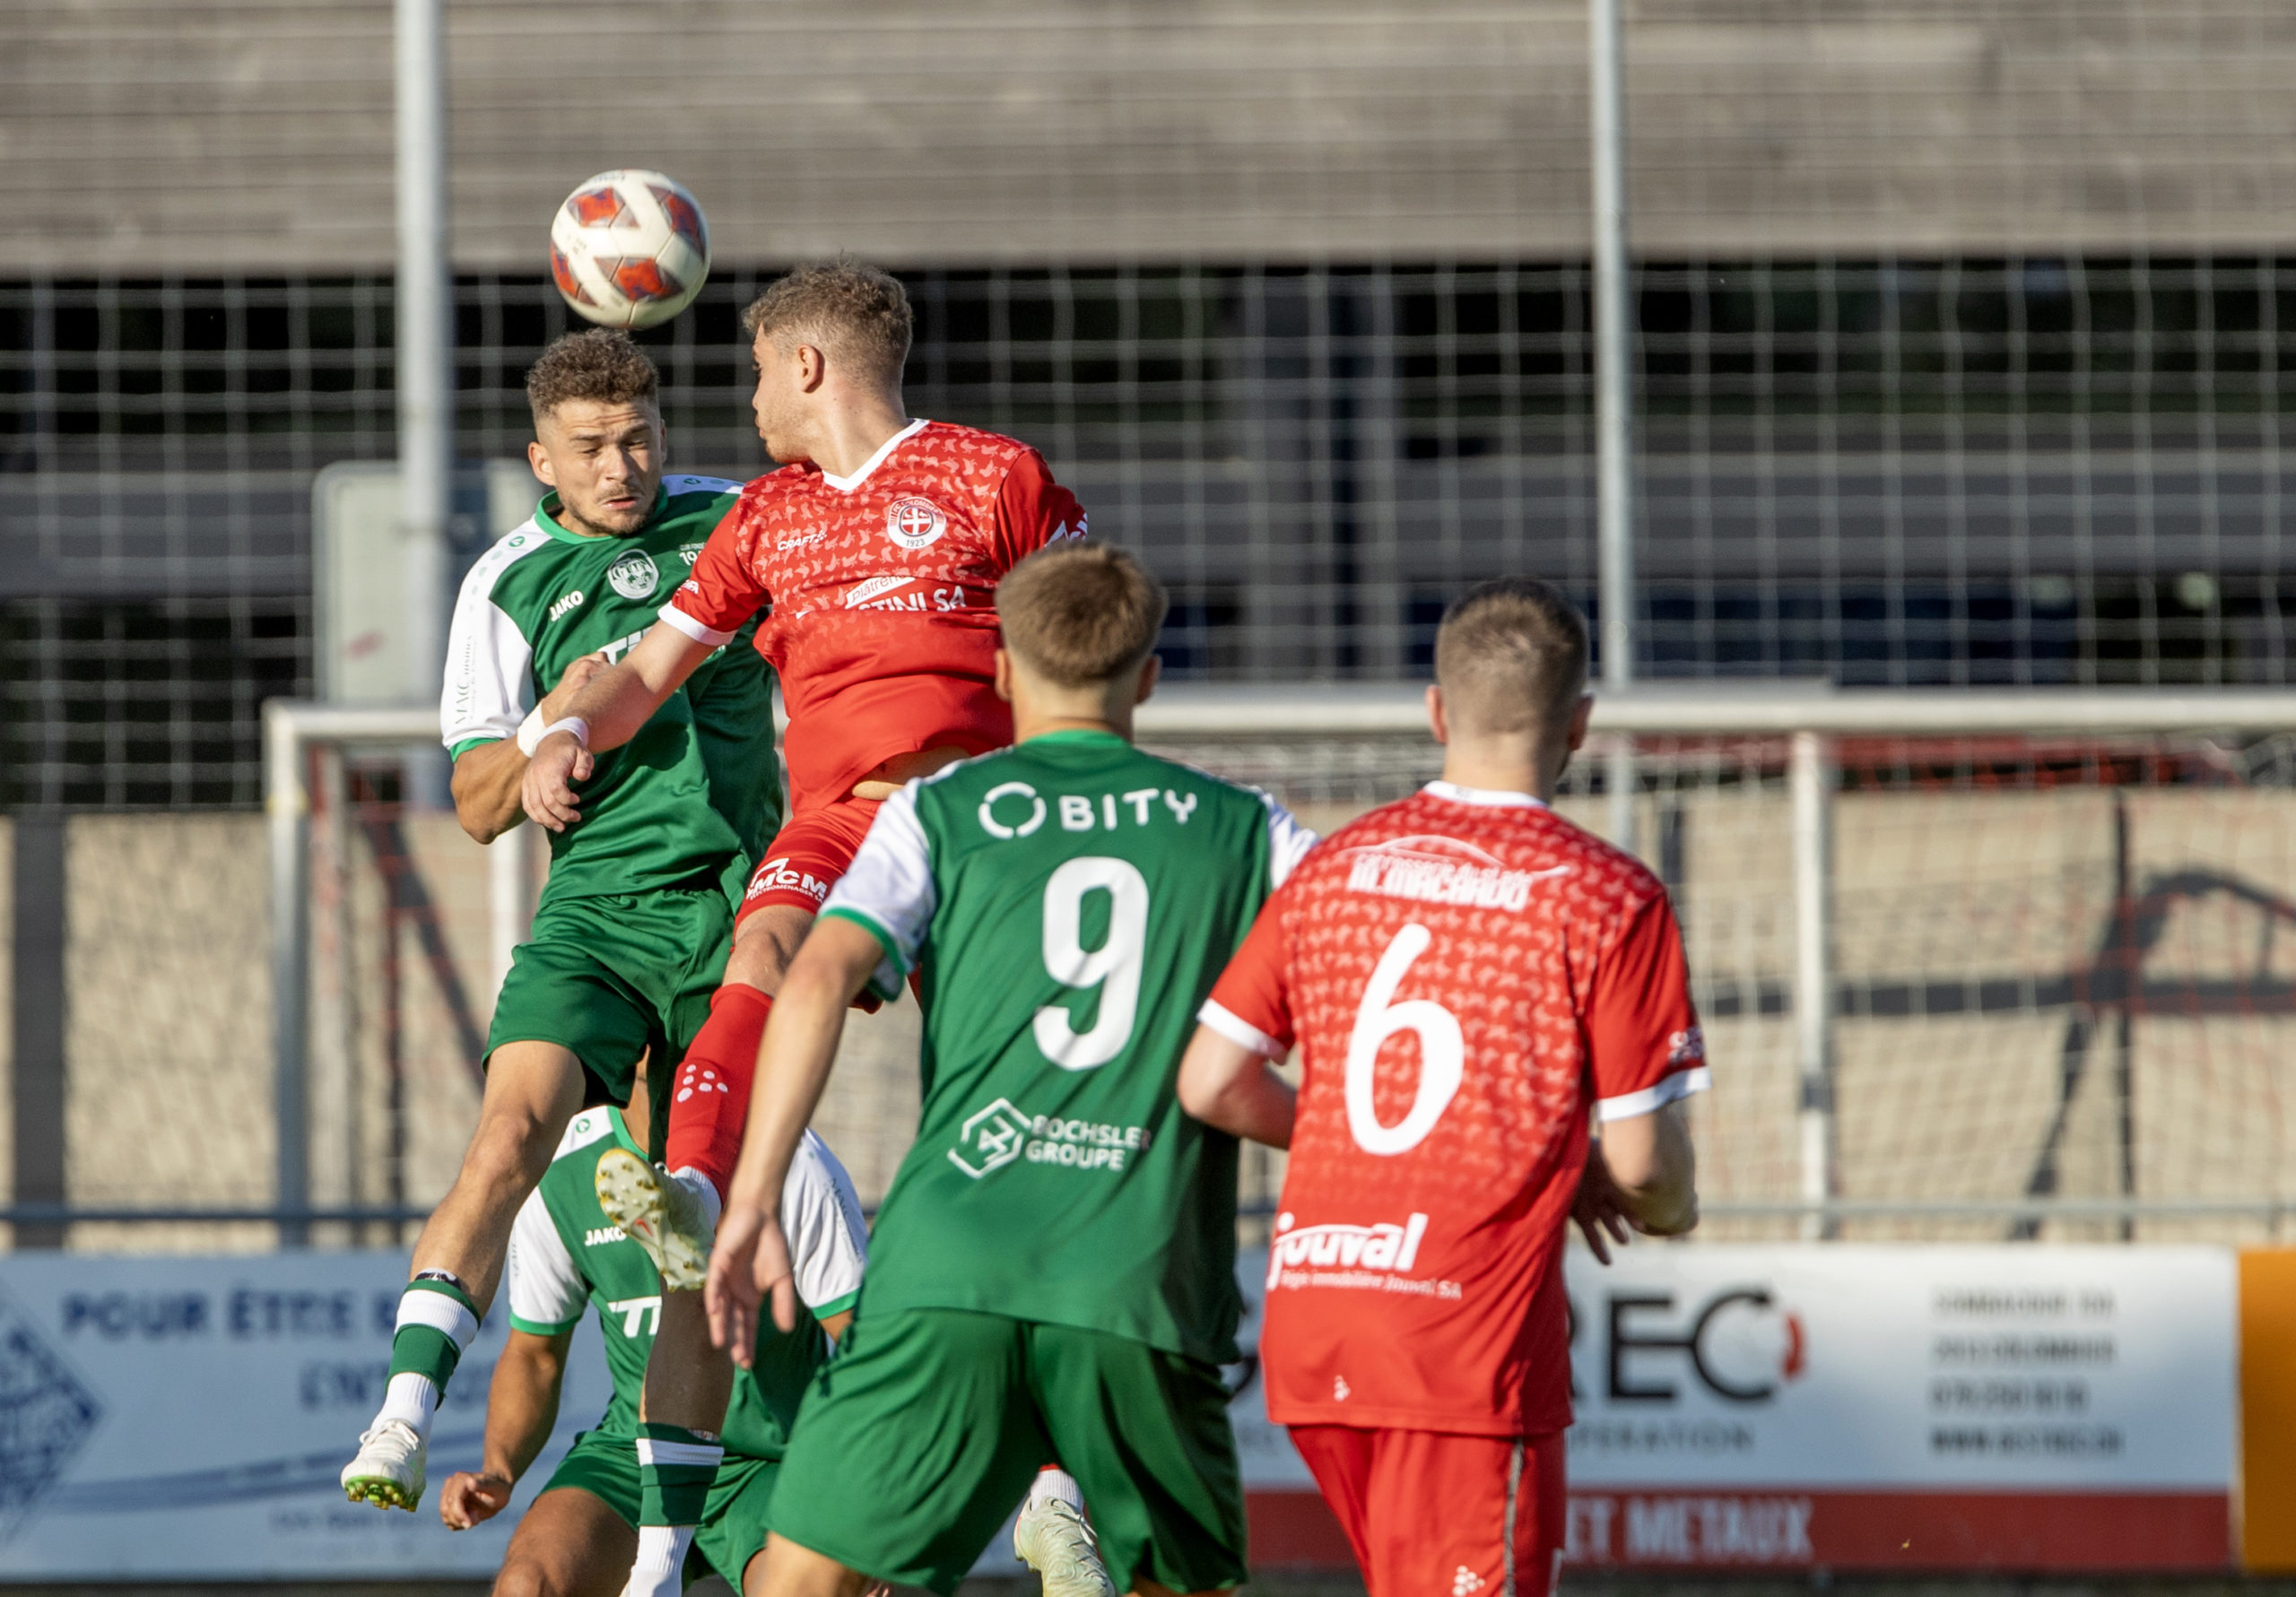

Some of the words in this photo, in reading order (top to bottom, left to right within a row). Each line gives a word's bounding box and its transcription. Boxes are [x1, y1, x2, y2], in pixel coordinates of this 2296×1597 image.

[777, 533, 817, 551] CRAFT
[906, 538, 926, 547] 1923
[679, 550, 702, 566] 19
[549, 590, 584, 621] JAKO
[934, 586, 966, 612] SA
[745, 870, 827, 900] MCM
[1033, 855, 1149, 1071] 9
[1346, 923, 1465, 1156] 6
[1025, 1140, 1126, 1171] GROUPE
[585, 1226, 627, 1246] JAKO
[1437, 1280, 1462, 1300] SA
[65, 1291, 206, 1333] POUR
